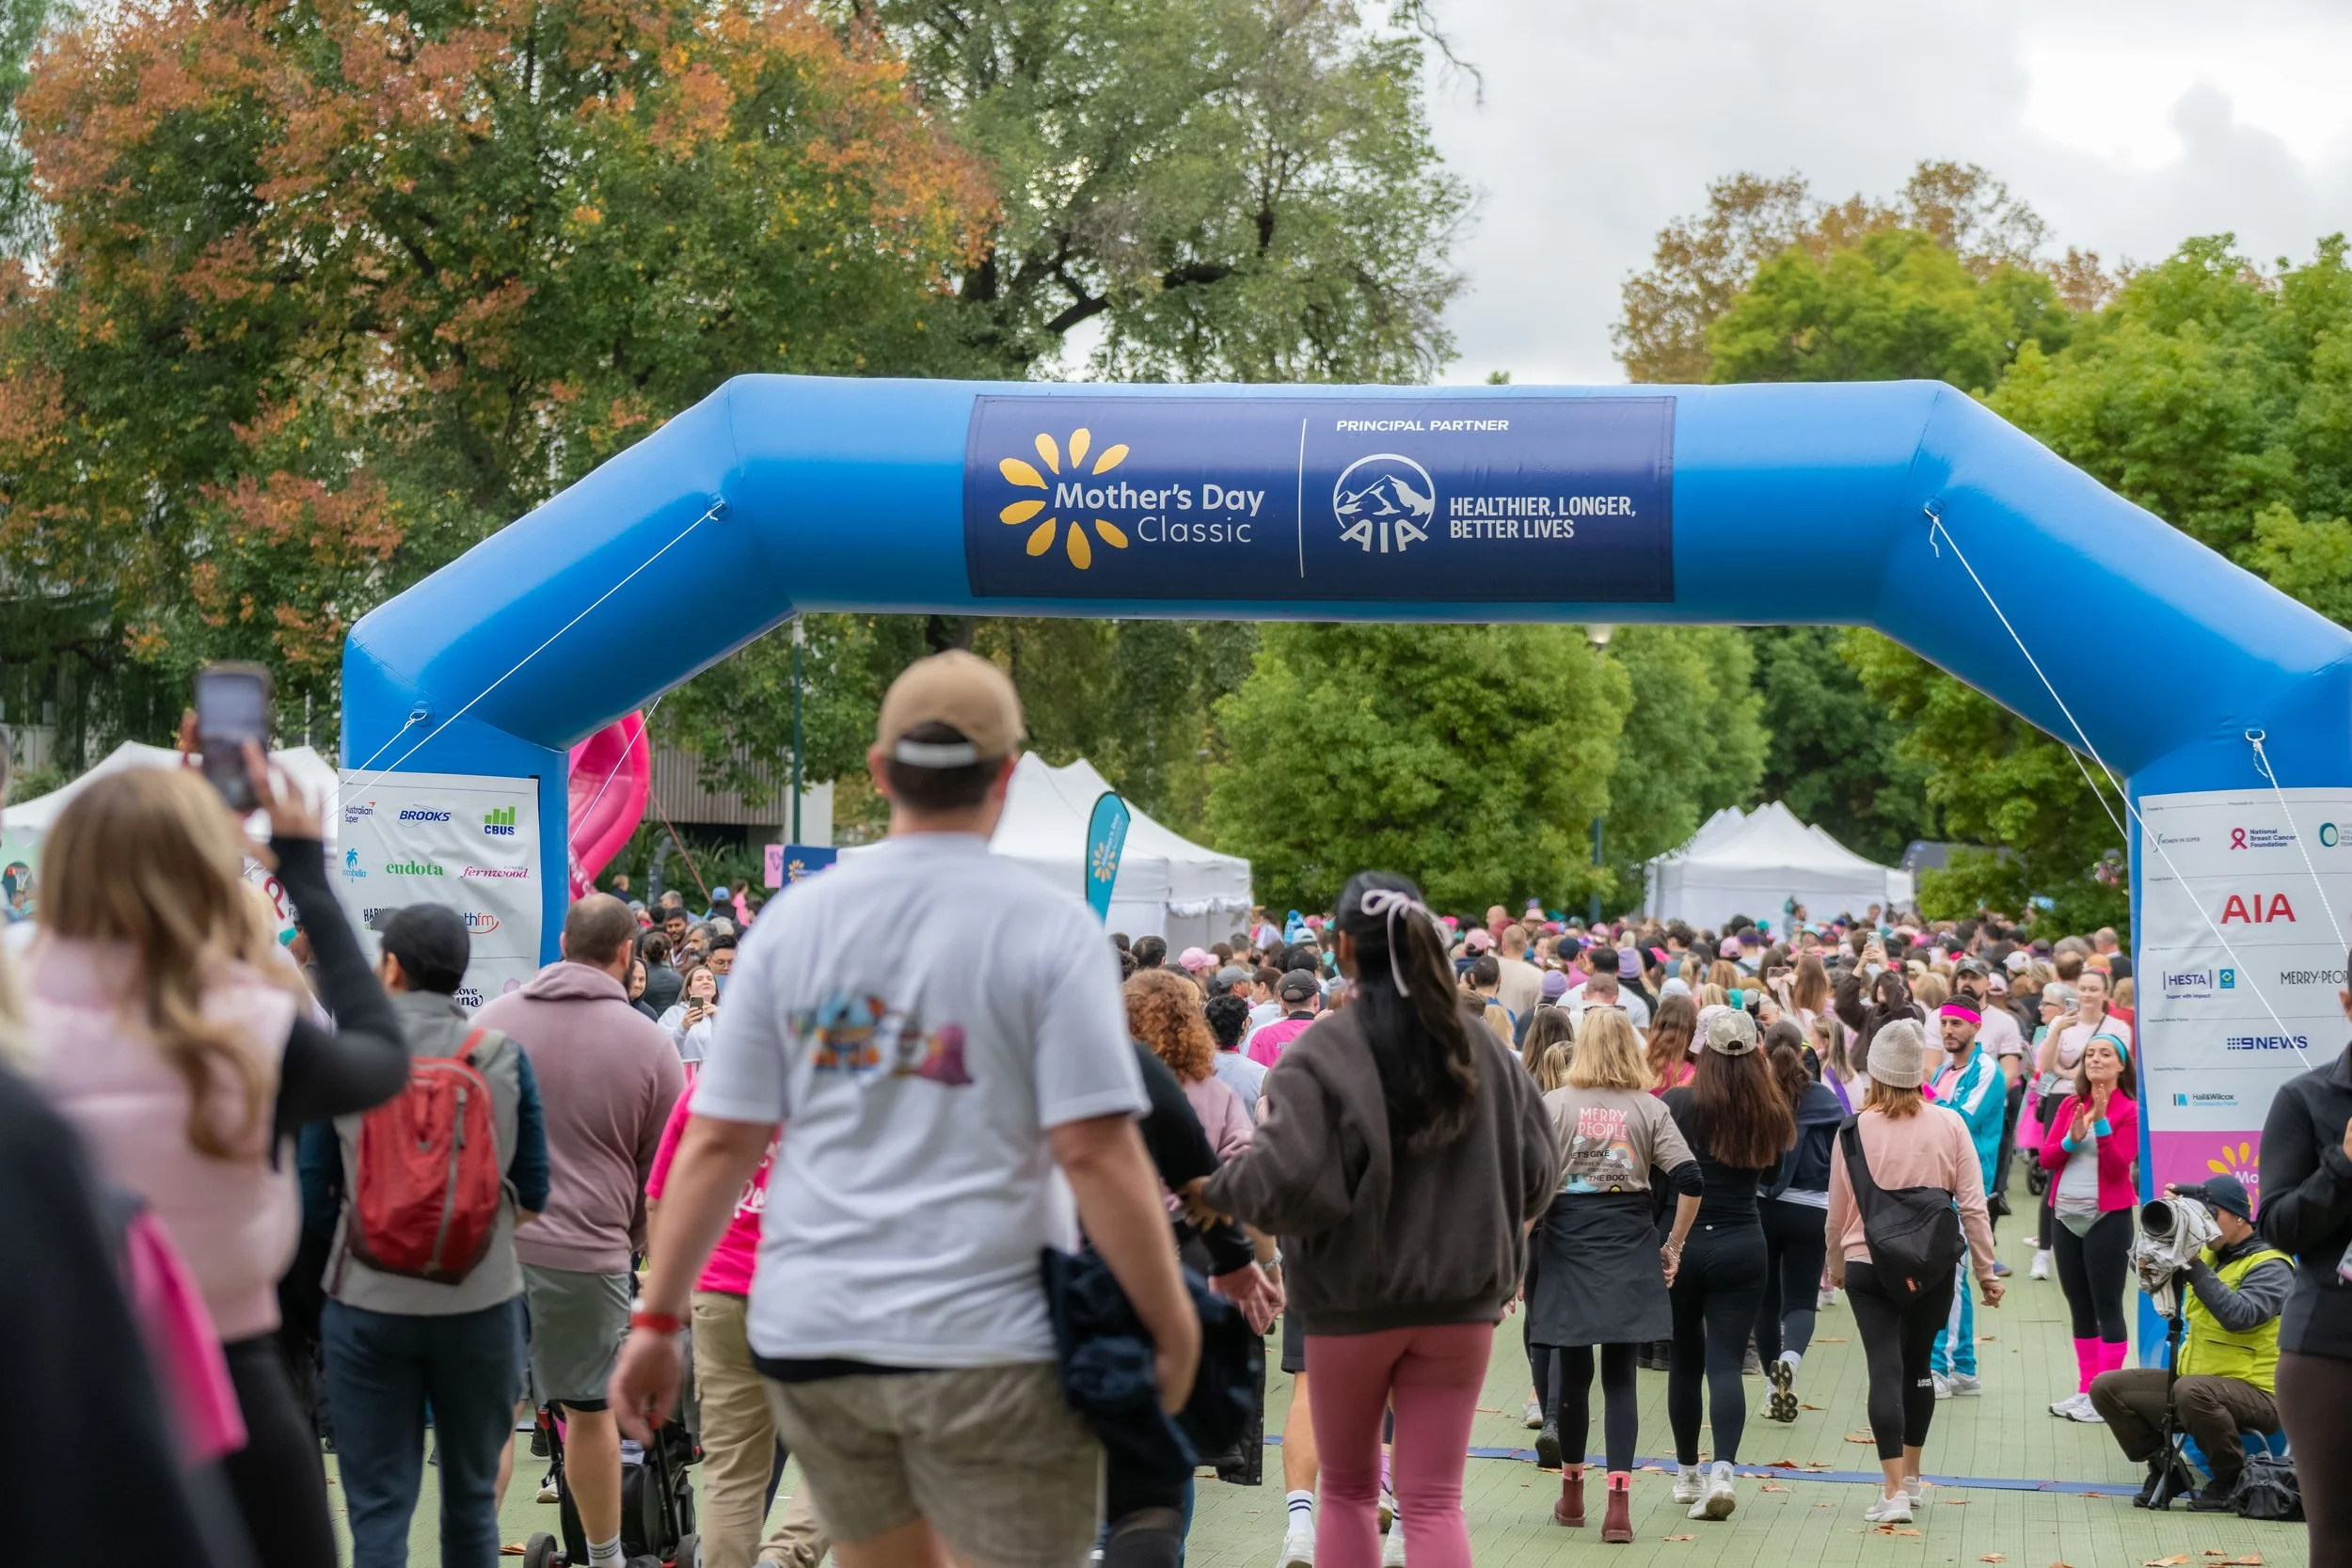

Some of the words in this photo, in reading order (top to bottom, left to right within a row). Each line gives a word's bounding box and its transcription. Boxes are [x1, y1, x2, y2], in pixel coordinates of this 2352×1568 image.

[1336, 420, 1425, 432] PRINCIPAL
[1429, 420, 1509, 432] PARTNER
[1054, 482, 1193, 511] Mother's
[1202, 483, 1265, 517] Day
[1450, 497, 1556, 517] HEALTHIER,
[1559, 496, 1637, 517] LONGER,
[1136, 515, 1252, 544] Classic
[1339, 518, 1429, 554] AIA
[1450, 520, 1519, 539] BETTER
[1523, 519, 1575, 539] LIVES
[399, 810, 452, 822] BROOKS
[484, 824, 516, 836] CBUS
[386, 861, 444, 877] endota
[460, 865, 529, 879] fernwood
[2220, 894, 2296, 924] AIA
[2169, 974, 2206, 986] HESTA
[1580, 1107, 1628, 1122] MERRY
[1578, 1121, 1628, 1138] PEOPLE
[1590, 1149, 1610, 1158] GIVE
[1589, 1174, 1605, 1182] THE
